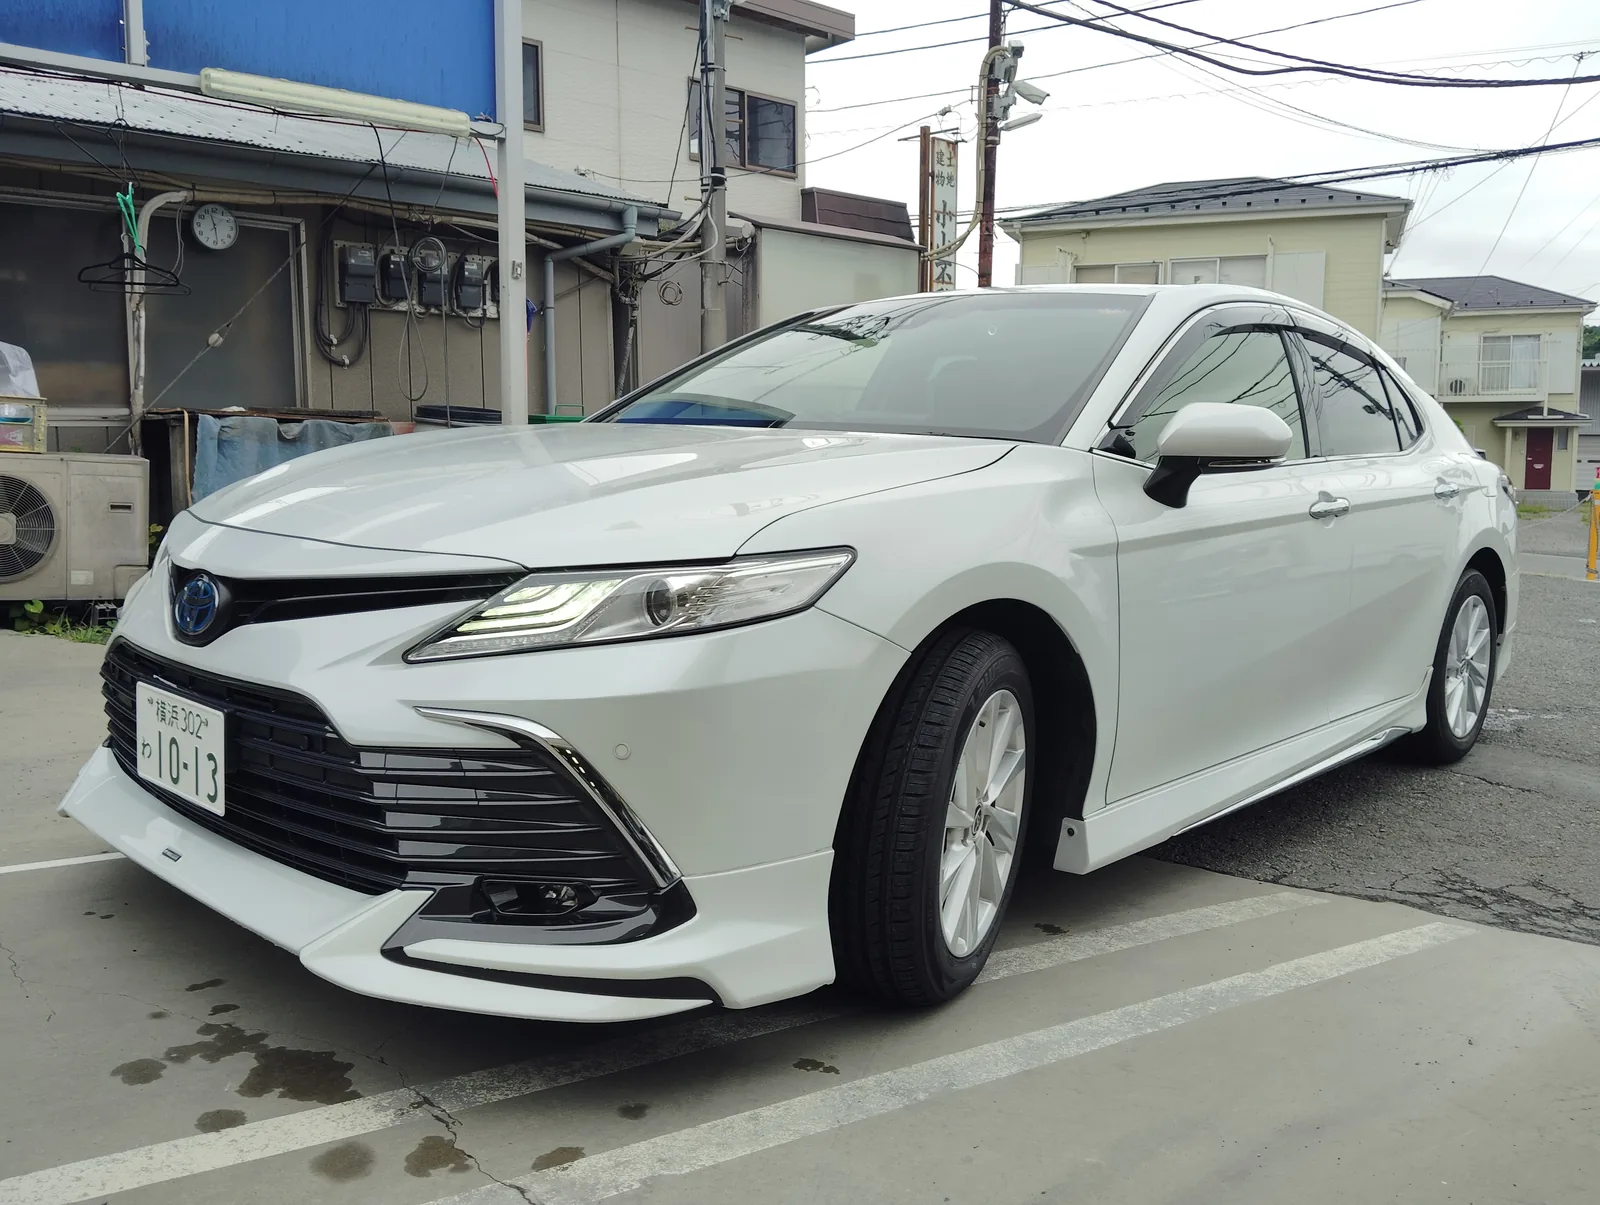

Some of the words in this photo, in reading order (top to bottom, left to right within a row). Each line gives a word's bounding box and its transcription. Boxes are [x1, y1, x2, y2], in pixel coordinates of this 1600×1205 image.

[935, 149, 946, 187] 建物
[945, 151, 955, 188] 土地
[935, 199, 953, 292] 小山不
[141, 736, 152, 759] わ
[158, 730, 218, 804] 10-13
